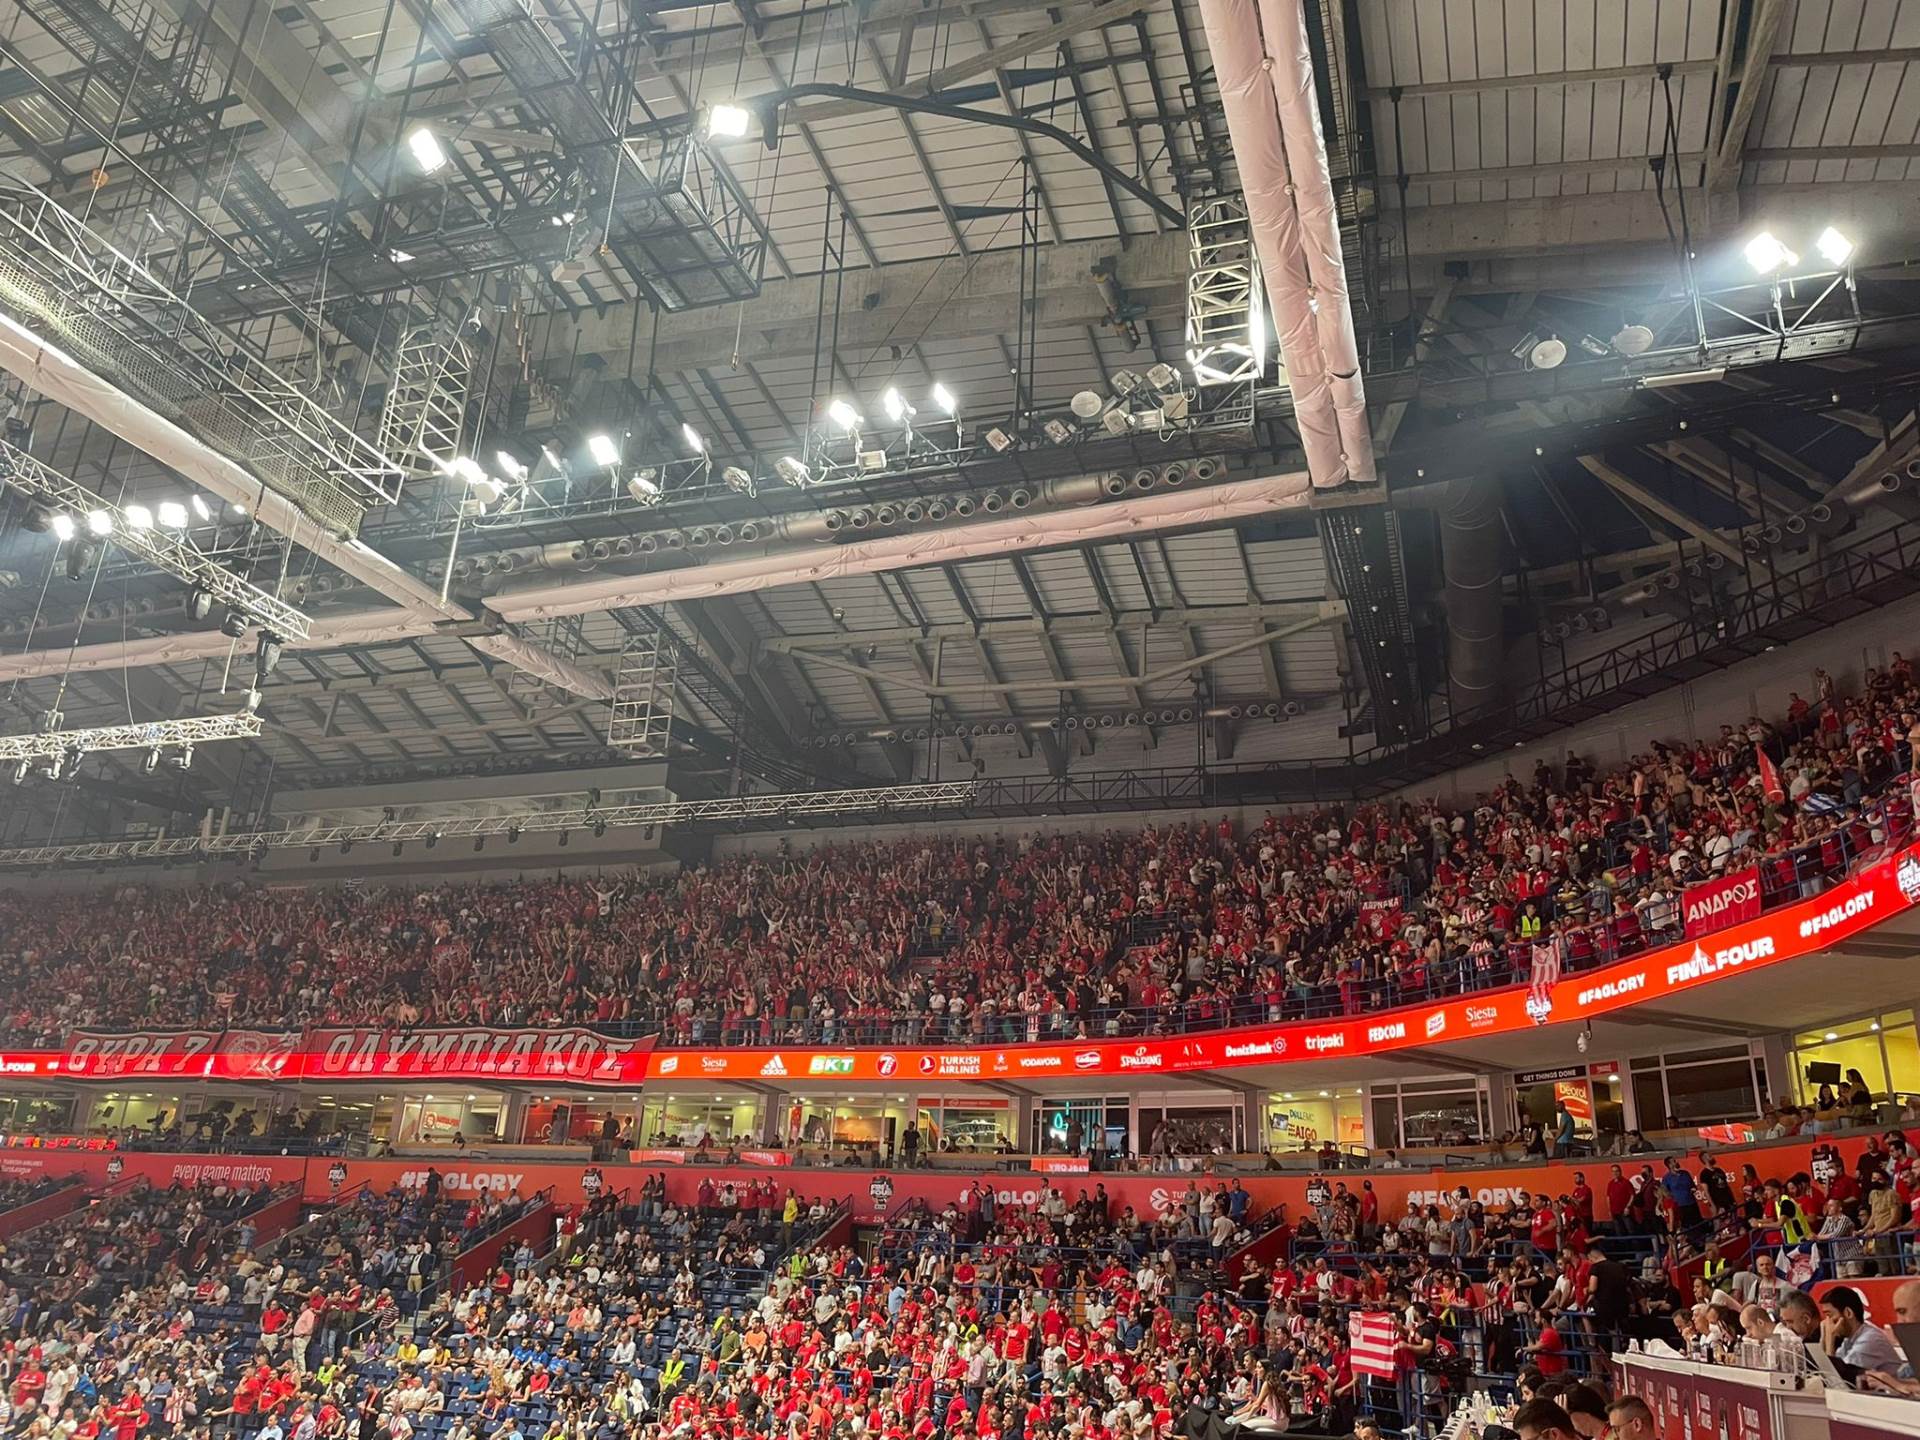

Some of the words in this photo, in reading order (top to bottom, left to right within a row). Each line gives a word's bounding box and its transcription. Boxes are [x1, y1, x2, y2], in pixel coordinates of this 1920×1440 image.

[1715, 937, 1775, 970] FOUR
[1466, 1006, 1498, 1022] Siesta
[1368, 1023, 1405, 1042] FEDCOM
[172, 1036, 210, 1072] 7
[322, 1032, 634, 1080] ΟΛΥΜΠΙΑΚΟΣ
[1225, 1042, 1273, 1058] DenizBank
[6, 1061, 37, 1073] FOUR
[702, 1056, 727, 1068] Siesta
[811, 1056, 854, 1073] BKT
[939, 1055, 980, 1065] TURKISH
[1020, 1057, 1062, 1067] VODAVODA
[1120, 1054, 1162, 1067] SPALDING
[760, 1068, 788, 1076] adidas
[939, 1064, 980, 1075] AIRLINES
[1523, 1073, 1534, 1082] GET
[1536, 1071, 1557, 1081] THINGS
[1558, 1069, 1577, 1078] DONE
[1559, 1082, 1586, 1099] beorol
[173, 1164, 200, 1184] every
[202, 1165, 231, 1184] game
[232, 1163, 272, 1183] matters
[401, 1171, 524, 1192] #FGLORY
